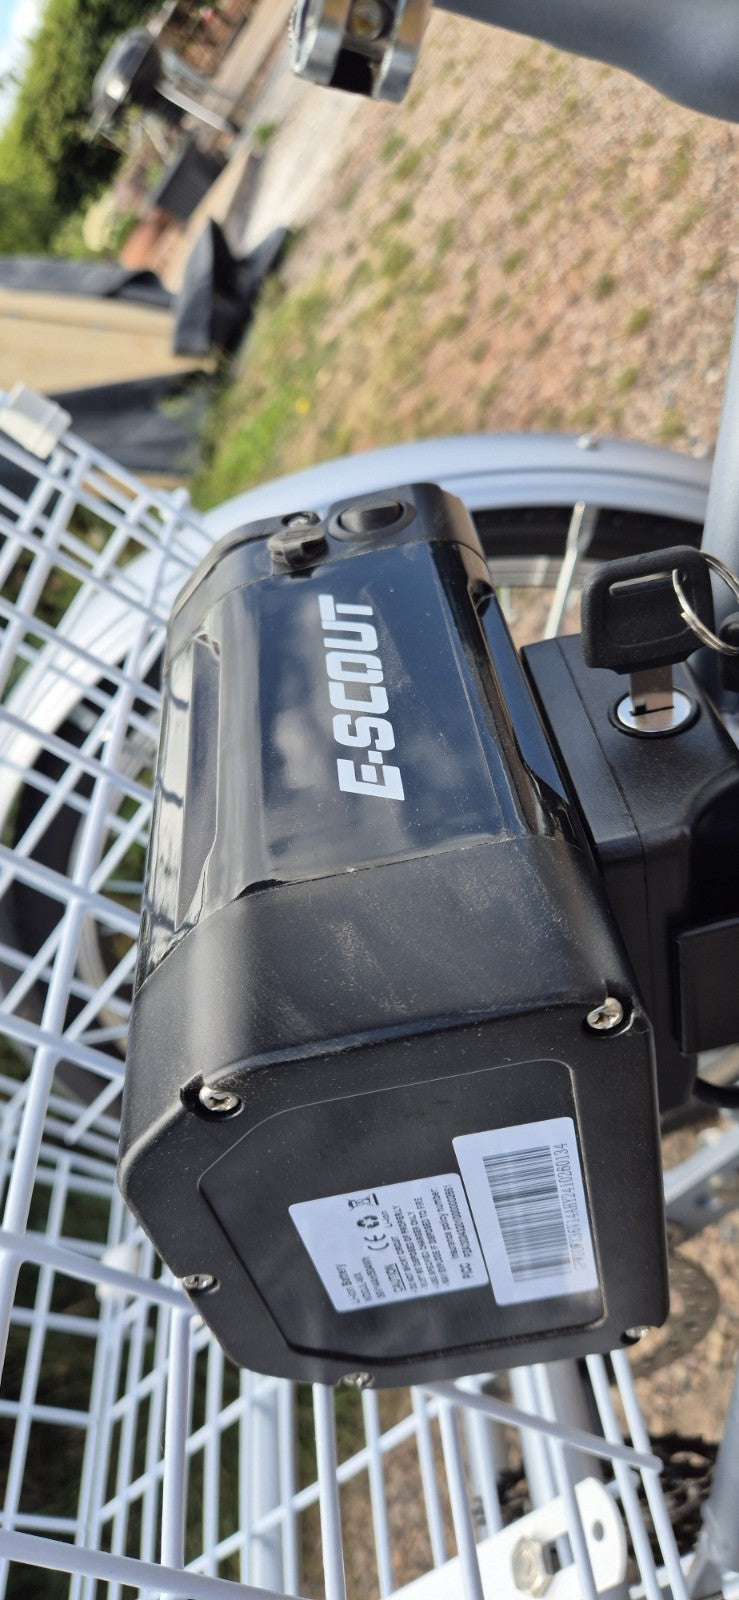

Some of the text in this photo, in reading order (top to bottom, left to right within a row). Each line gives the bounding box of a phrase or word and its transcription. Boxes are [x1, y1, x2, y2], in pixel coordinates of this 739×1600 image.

[318, 593, 405, 801] E-SCOUT
[413, 1196, 425, 1209] FIRE
[379, 1209, 393, 1228] Li-ion
[391, 1204, 409, 1234] PROPERLY
[406, 1210, 418, 1225] ONLY
[437, 1212, 452, 1231] policy
[411, 1225, 427, 1250] CHARGER
[420, 1218, 436, 1244] DISPOSED
[390, 1235, 404, 1255] CIRCUIT
[405, 1241, 421, 1266] DISPOSED
[443, 1230, 459, 1259] Insurance
[397, 1254, 411, 1272] SHORT
[420, 1250, 435, 1275] SPECIFIED
[431, 1249, 446, 1273] EXPLODE
[458, 1261, 474, 1279] PICC
[332, 1262, 354, 1286] Battery
[383, 1262, 404, 1293] CAUTION
